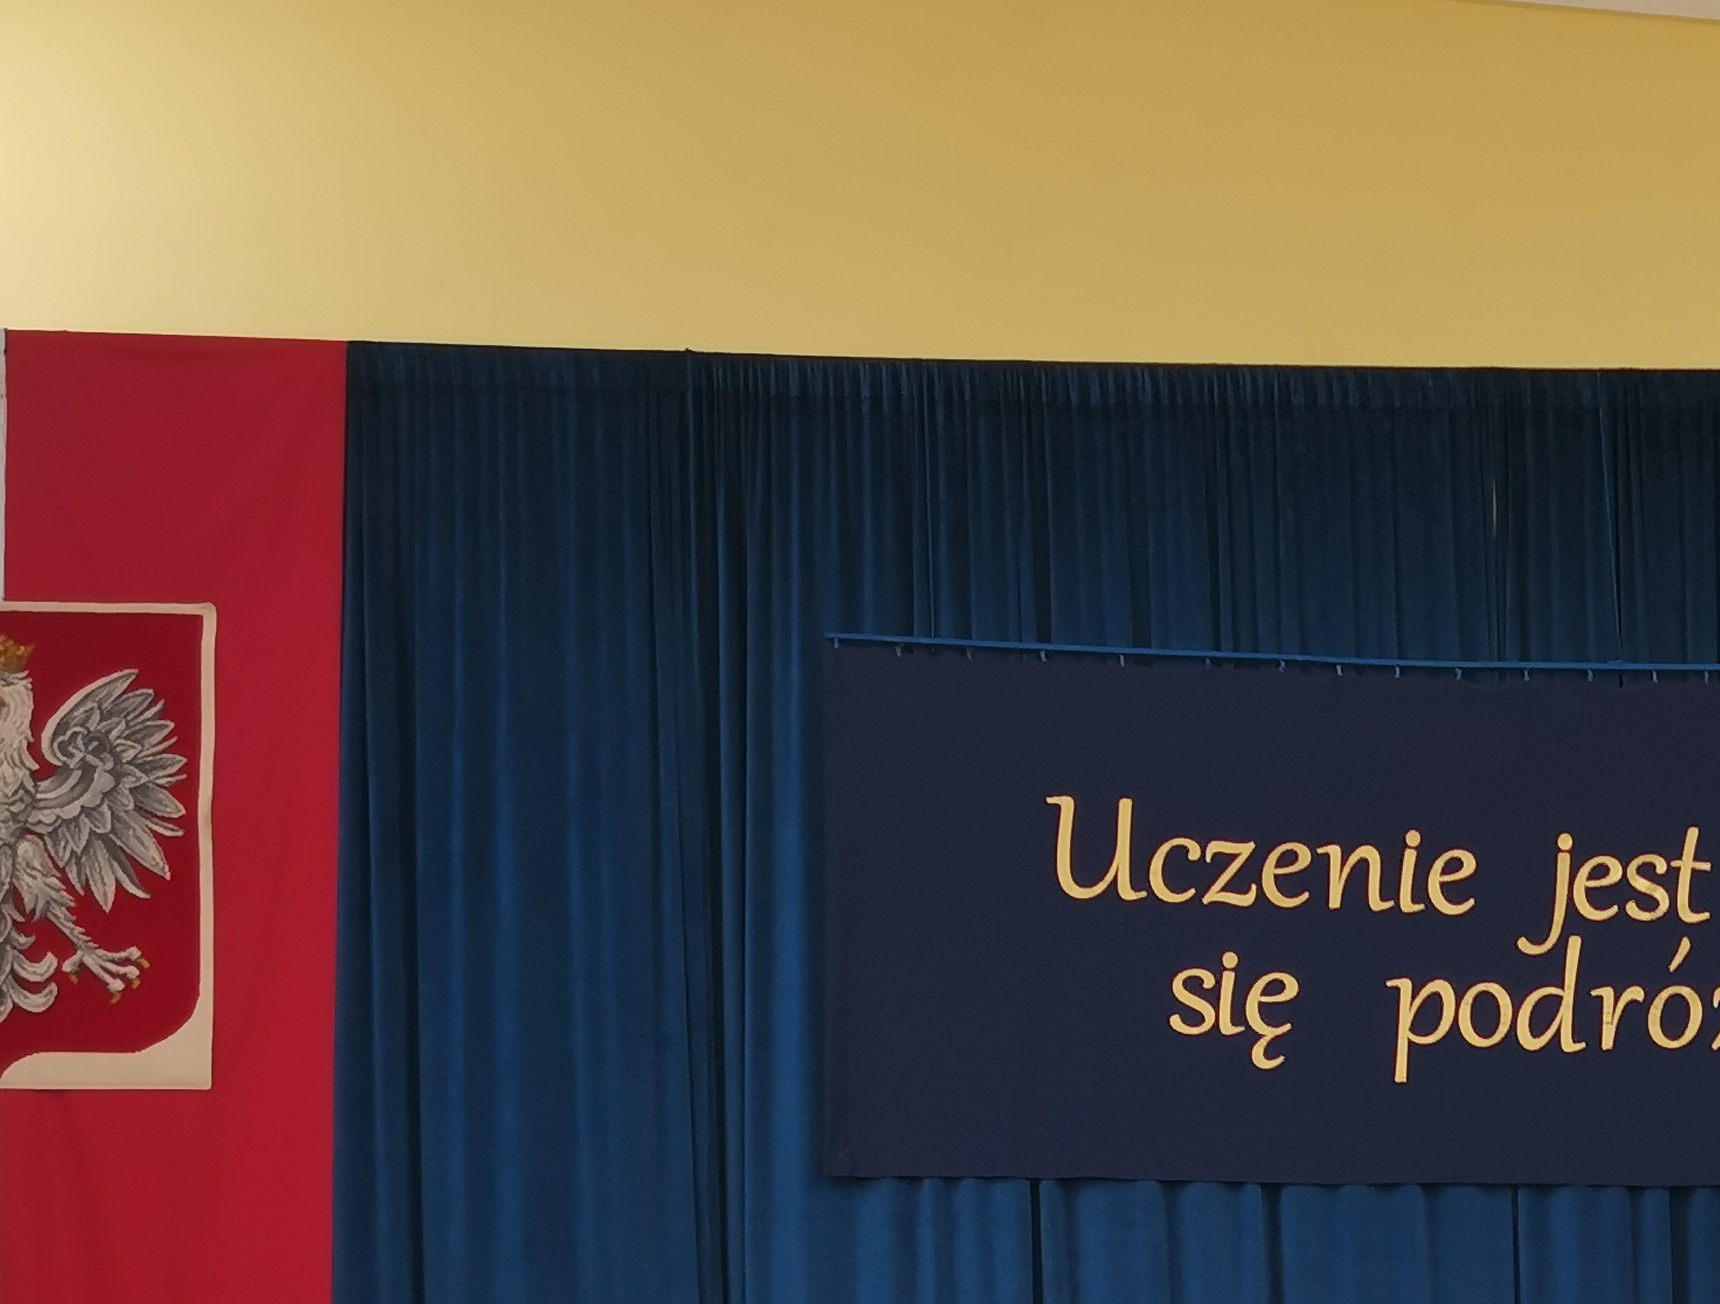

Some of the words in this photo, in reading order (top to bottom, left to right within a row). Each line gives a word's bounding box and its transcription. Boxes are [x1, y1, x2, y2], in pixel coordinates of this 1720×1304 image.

[1045, 794, 1477, 916] Uczenie
[1516, 826, 1712, 956] jest
[1169, 951, 1299, 1070] się
